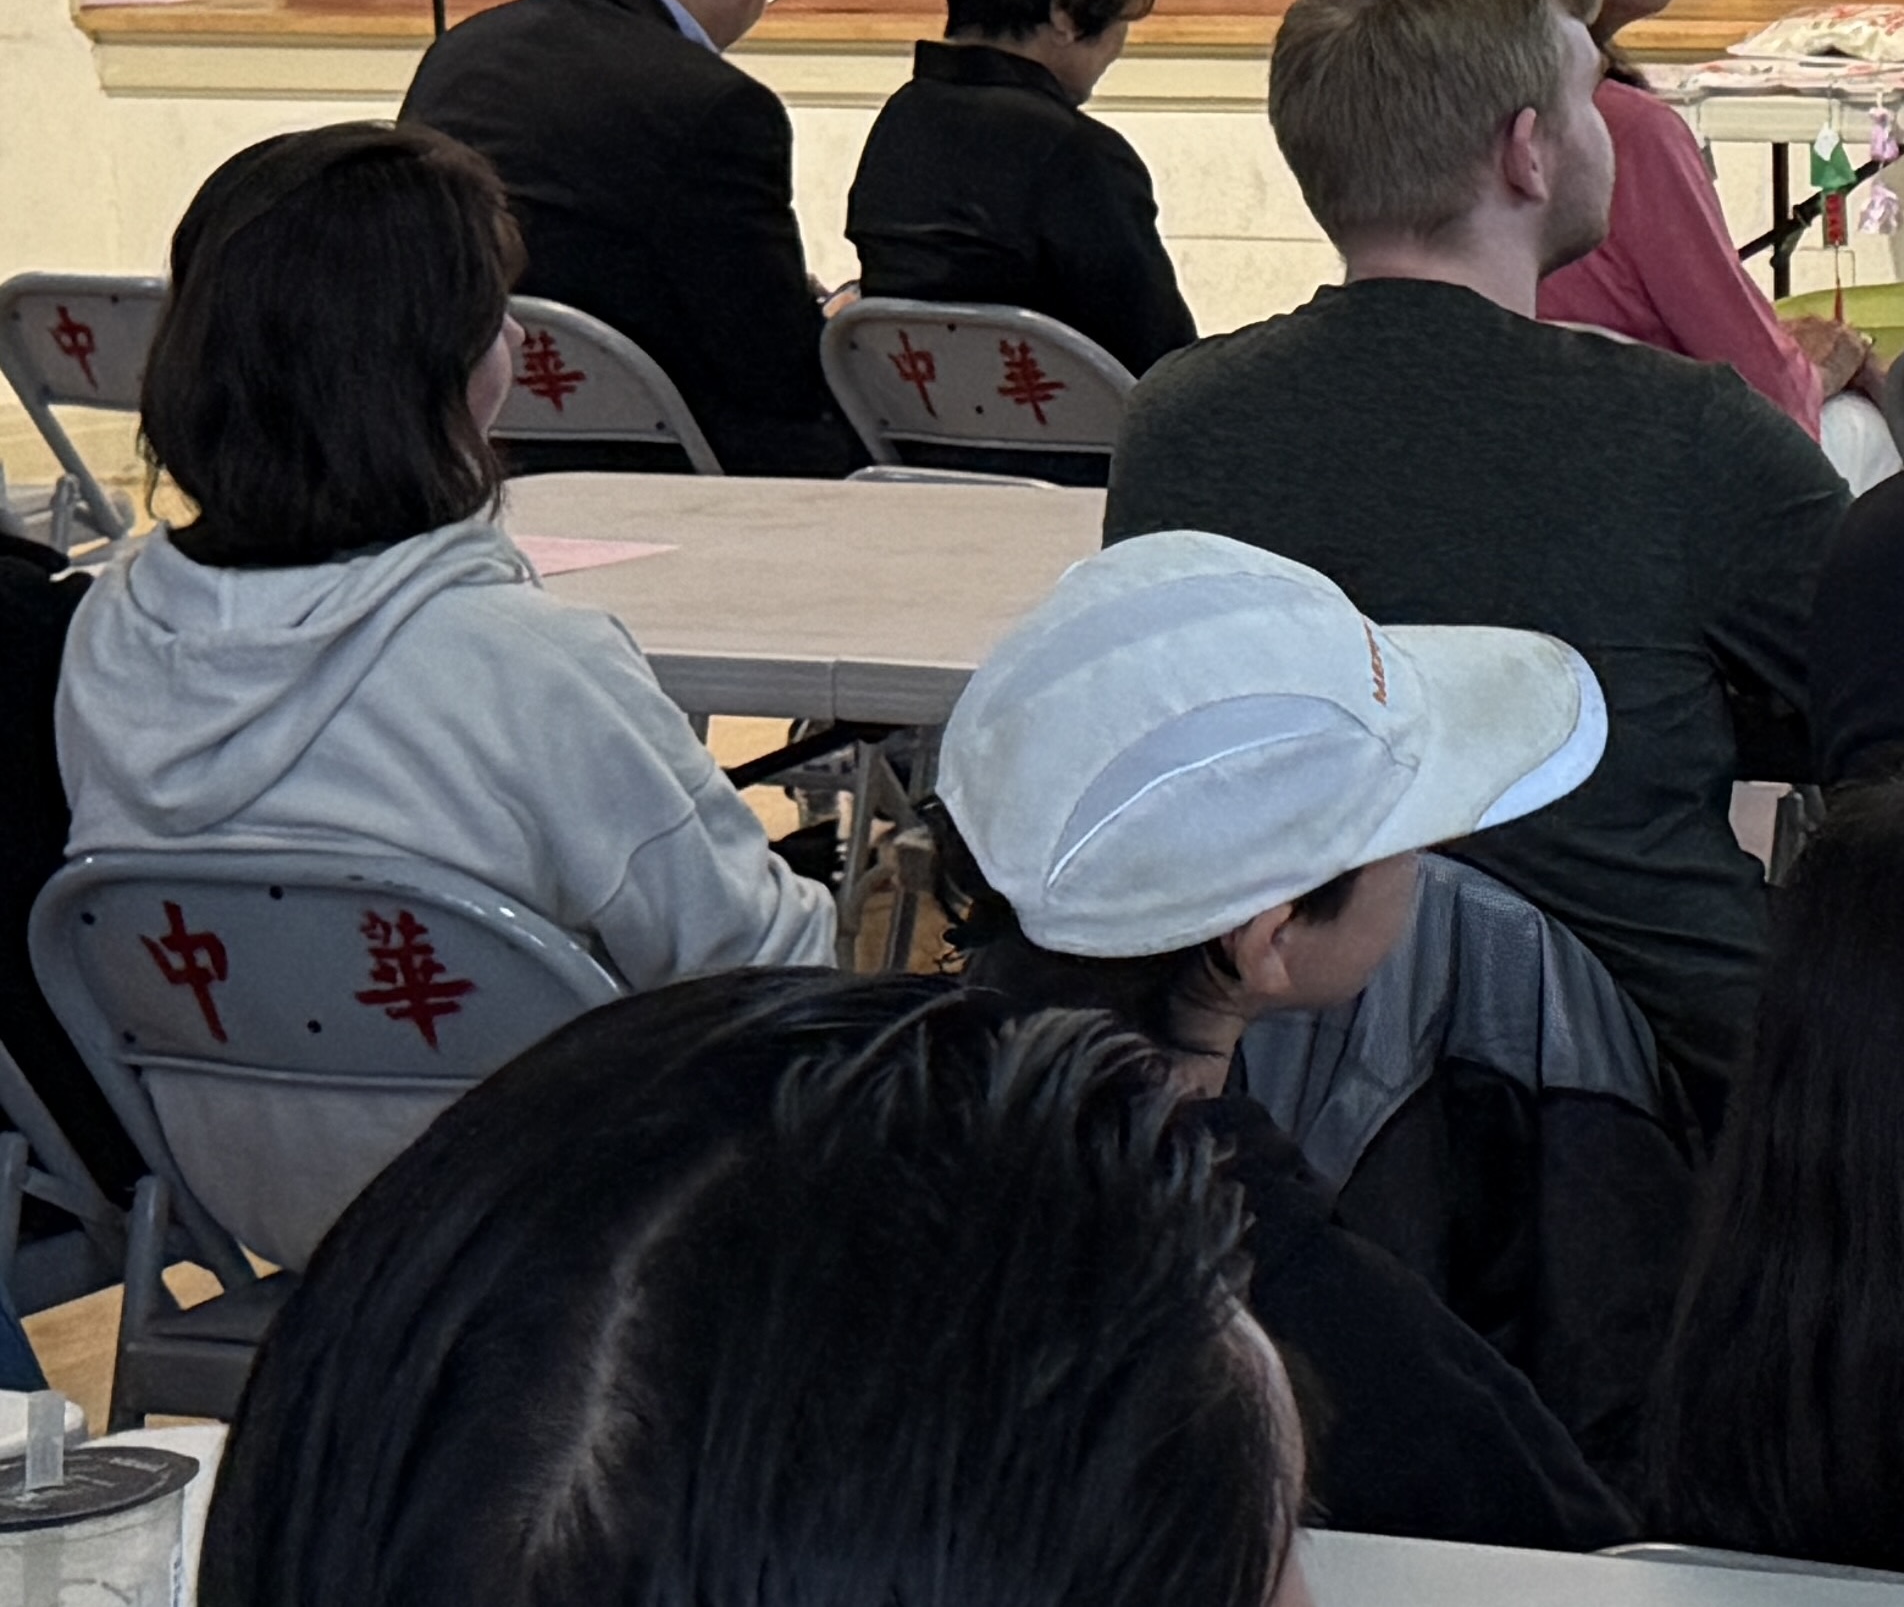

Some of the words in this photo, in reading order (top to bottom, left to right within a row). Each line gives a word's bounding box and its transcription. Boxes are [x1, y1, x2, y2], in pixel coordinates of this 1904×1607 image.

[47, 305, 98, 390] 中
[516, 328, 586, 413] 華
[139, 900, 478, 1053] 中華
